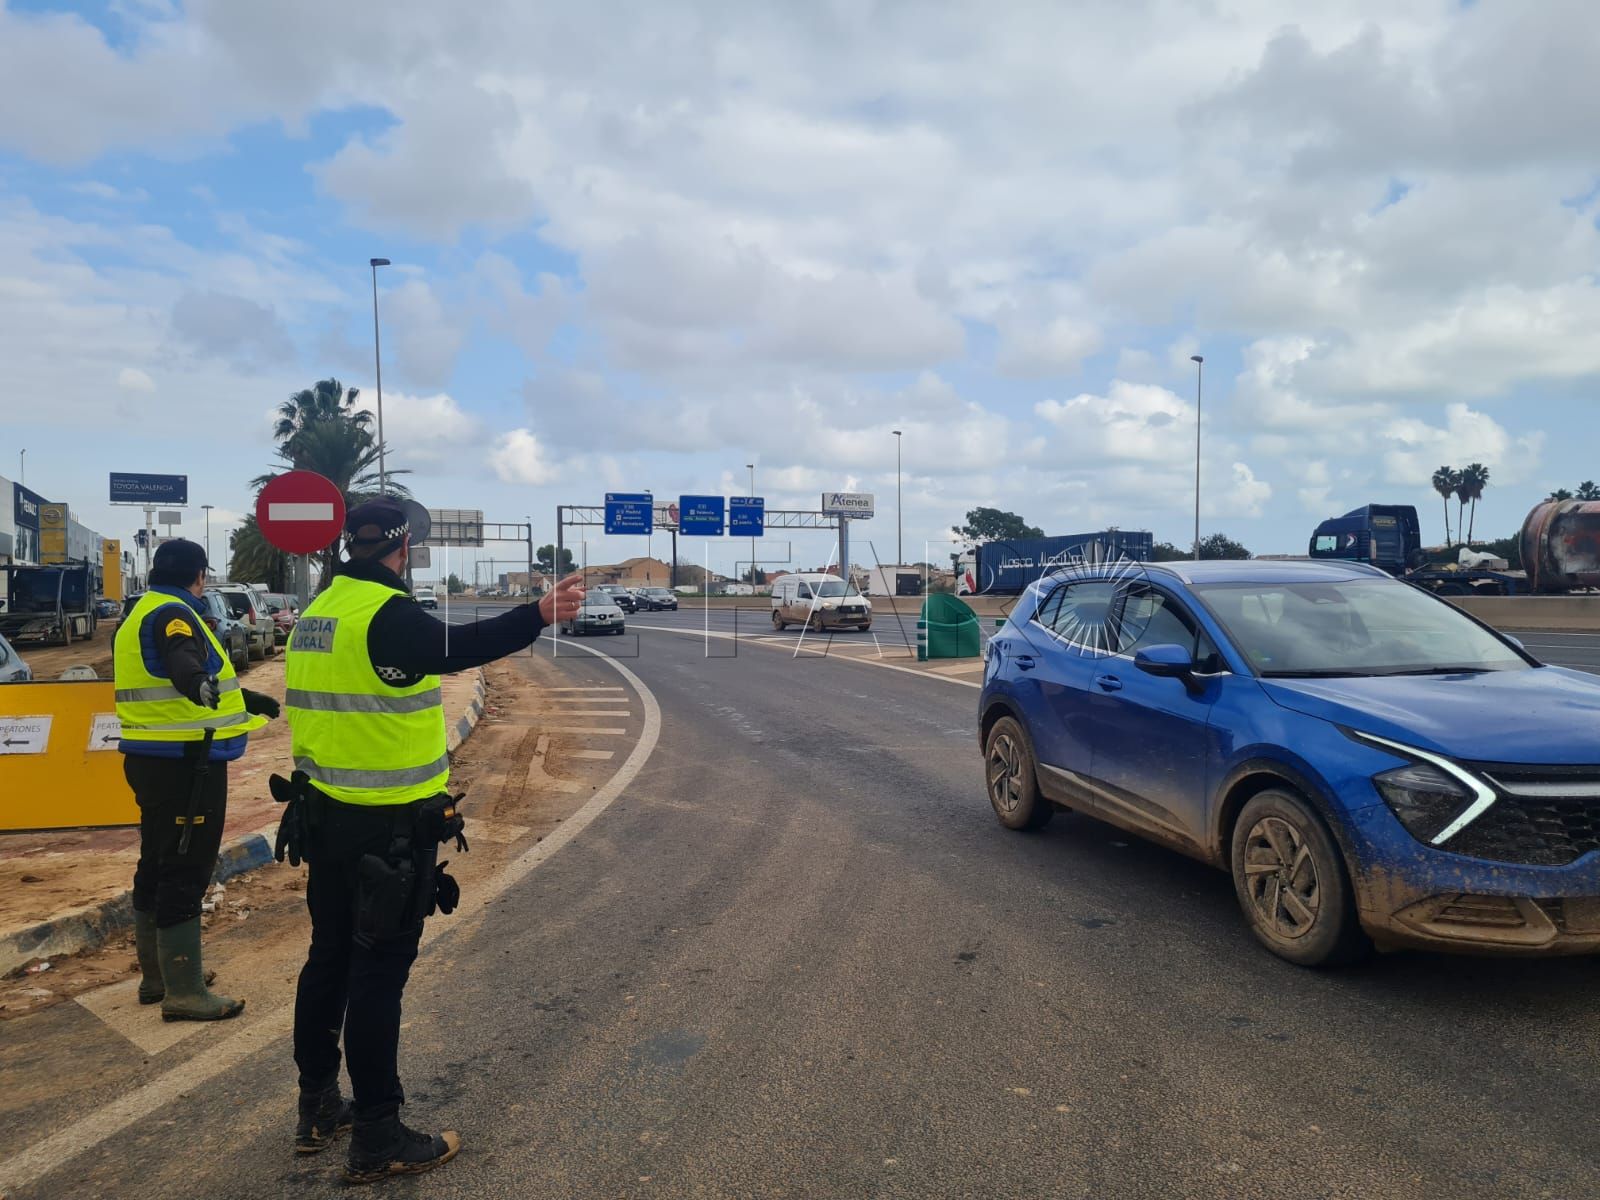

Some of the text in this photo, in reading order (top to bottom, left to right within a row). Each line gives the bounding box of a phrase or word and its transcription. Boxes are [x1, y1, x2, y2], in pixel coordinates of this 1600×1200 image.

[830, 494, 869, 507] Atenea
[293, 635, 326, 649] LOCAL
[0, 725, 41, 735] PEATONES
